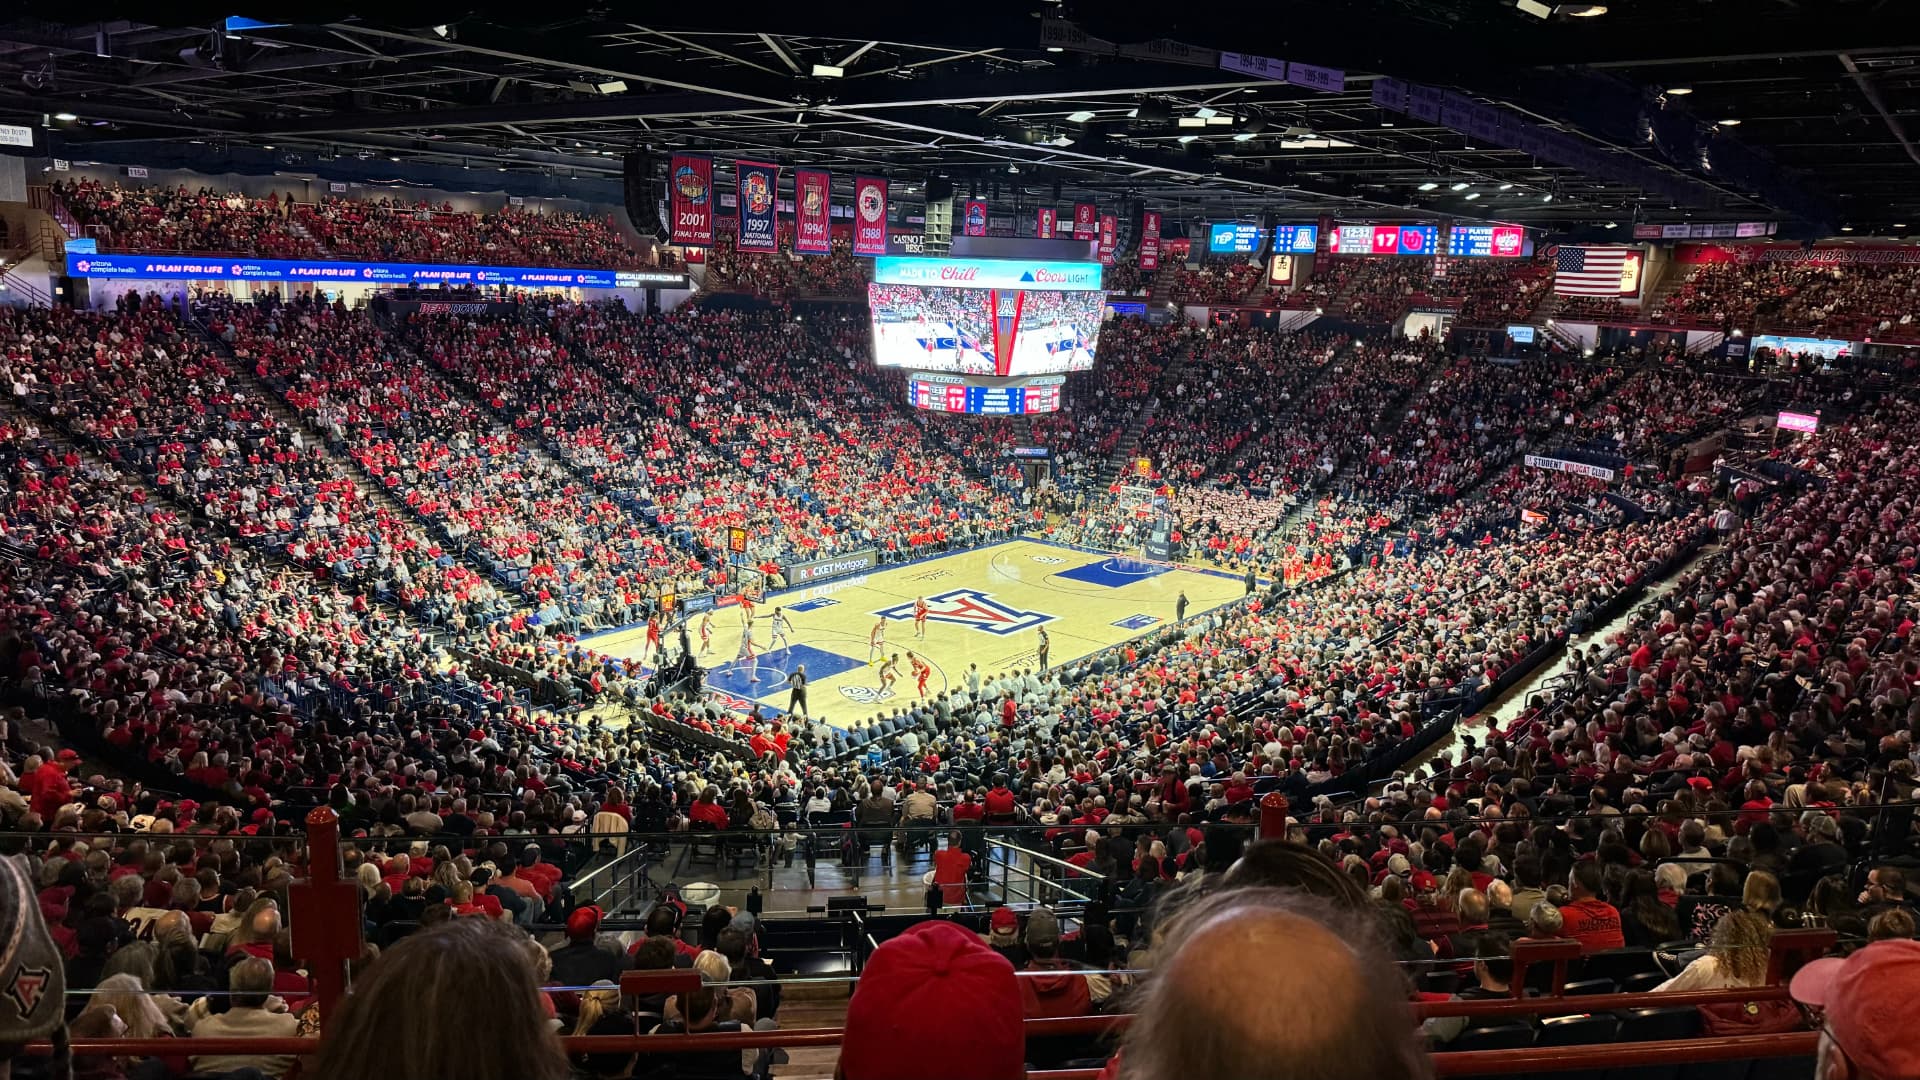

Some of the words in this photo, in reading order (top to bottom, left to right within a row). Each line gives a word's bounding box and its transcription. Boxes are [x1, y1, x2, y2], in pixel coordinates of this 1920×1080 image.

[680, 212, 705, 226] 2001
[747, 219, 769, 232] 1997
[803, 222, 824, 234] 1994
[674, 230, 692, 238] FINAL
[693, 230, 711, 239] FOUR
[744, 232, 772, 240] NATIONAL
[861, 227, 881, 239] 1988
[740, 239, 773, 247] CHAMPIONS
[893, 234, 918, 244] CASINO
[1376, 234, 1397, 247] 17
[905, 244, 924, 253] RESO
[145, 264, 154, 272] A
[155, 264, 182, 273] PLAN
[183, 264, 203, 273] FOR
[203, 265, 223, 274] LIFE
[298, 267, 320, 276] PLAN
[321, 268, 338, 276] FOR
[339, 268, 356, 277] LIFE
[941, 266, 980, 281] Chill
[420, 271, 440, 279] PLAN
[441, 271, 456, 279] FOR
[1035, 268, 1067, 283] Coors
[1067, 274, 1089, 284] LIGHT
[419, 303, 450, 314] BEAR
[450, 304, 488, 314] DOWN
[935, 375, 964, 384] CENTER
[919, 392, 929, 406] 18
[949, 397, 965, 409] 17
[1026, 398, 1039, 410] 18
[1533, 457, 1562, 469] STUDENT
[1564, 463, 1590, 476] WILDCAT
[1591, 467, 1607, 478] CLUB
[800, 563, 834, 580] ROCKET
[834, 558, 869, 571] Mortgage
